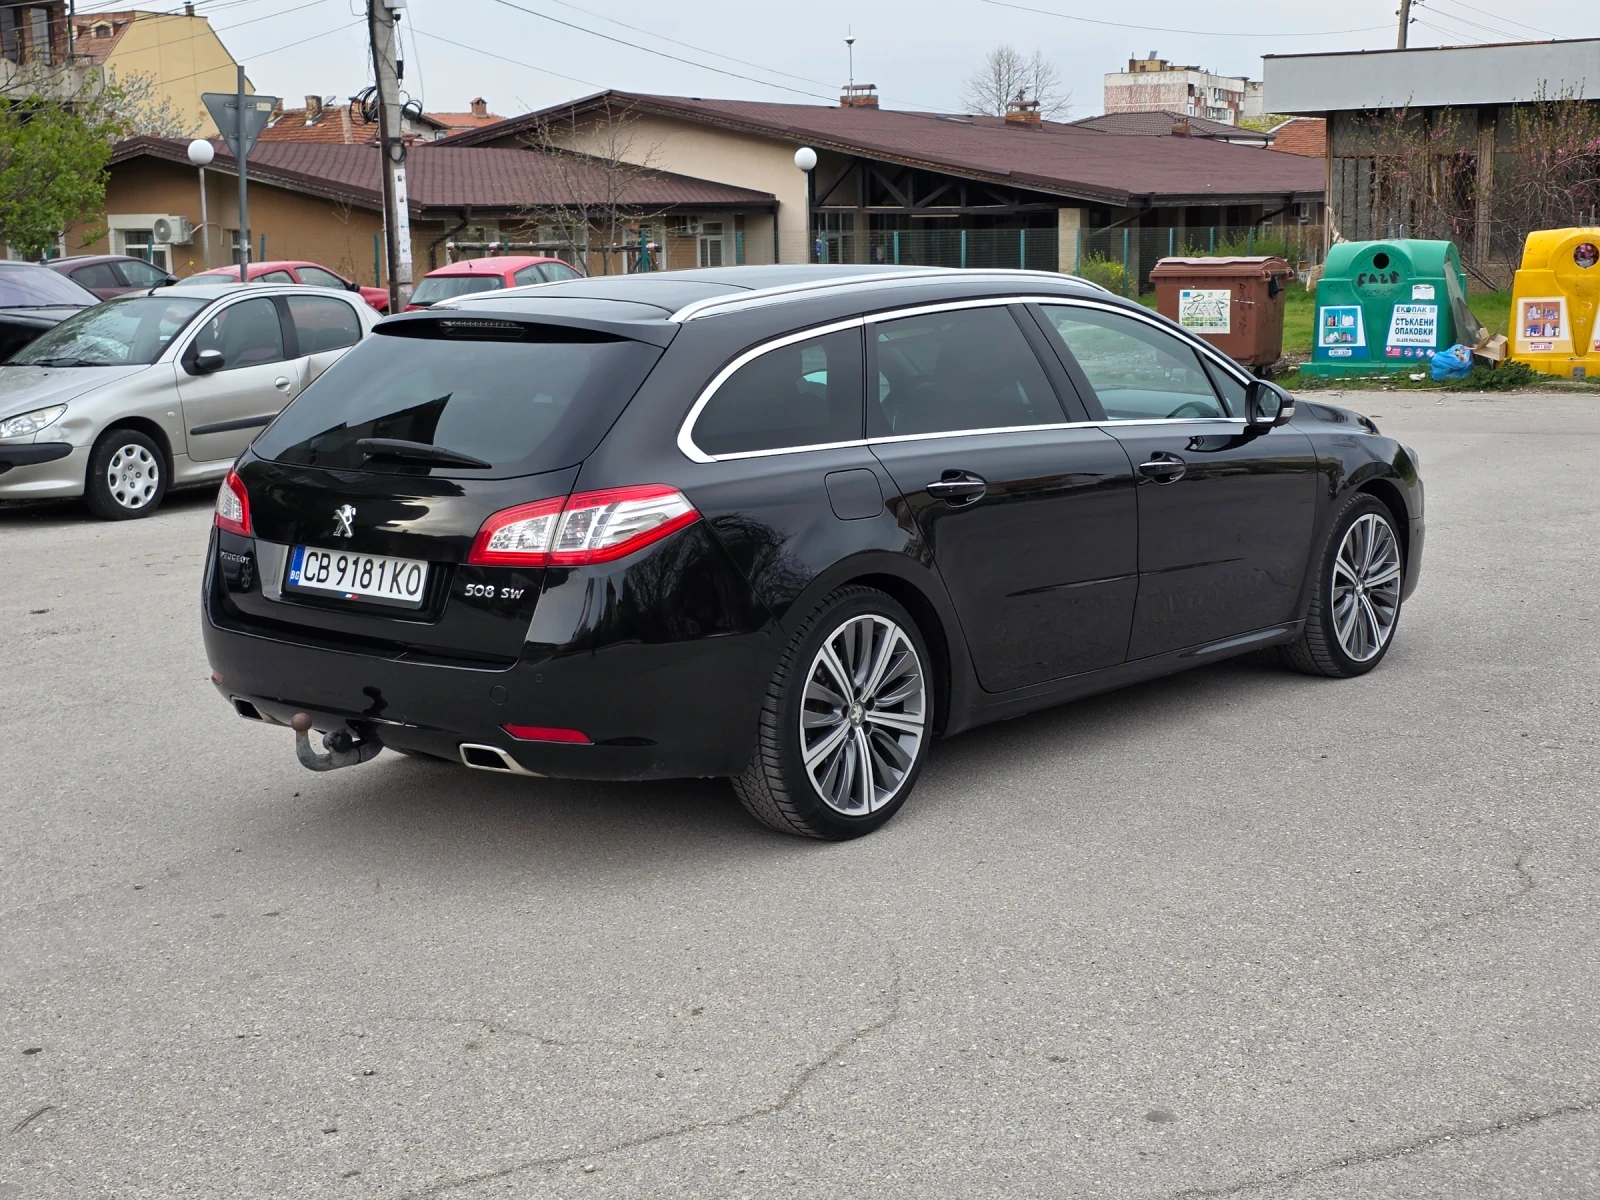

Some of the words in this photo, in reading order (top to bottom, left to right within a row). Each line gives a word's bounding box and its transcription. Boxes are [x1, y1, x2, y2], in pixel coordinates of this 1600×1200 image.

[1395, 317, 1434, 327] СТЪКЛЕНИ
[1394, 327, 1434, 336] ОПАКОВКИ
[220, 550, 250, 564] PEUGEOT
[290, 569, 300, 580] BG
[464, 583, 495, 598] 508
[500, 587, 525, 600] SW
